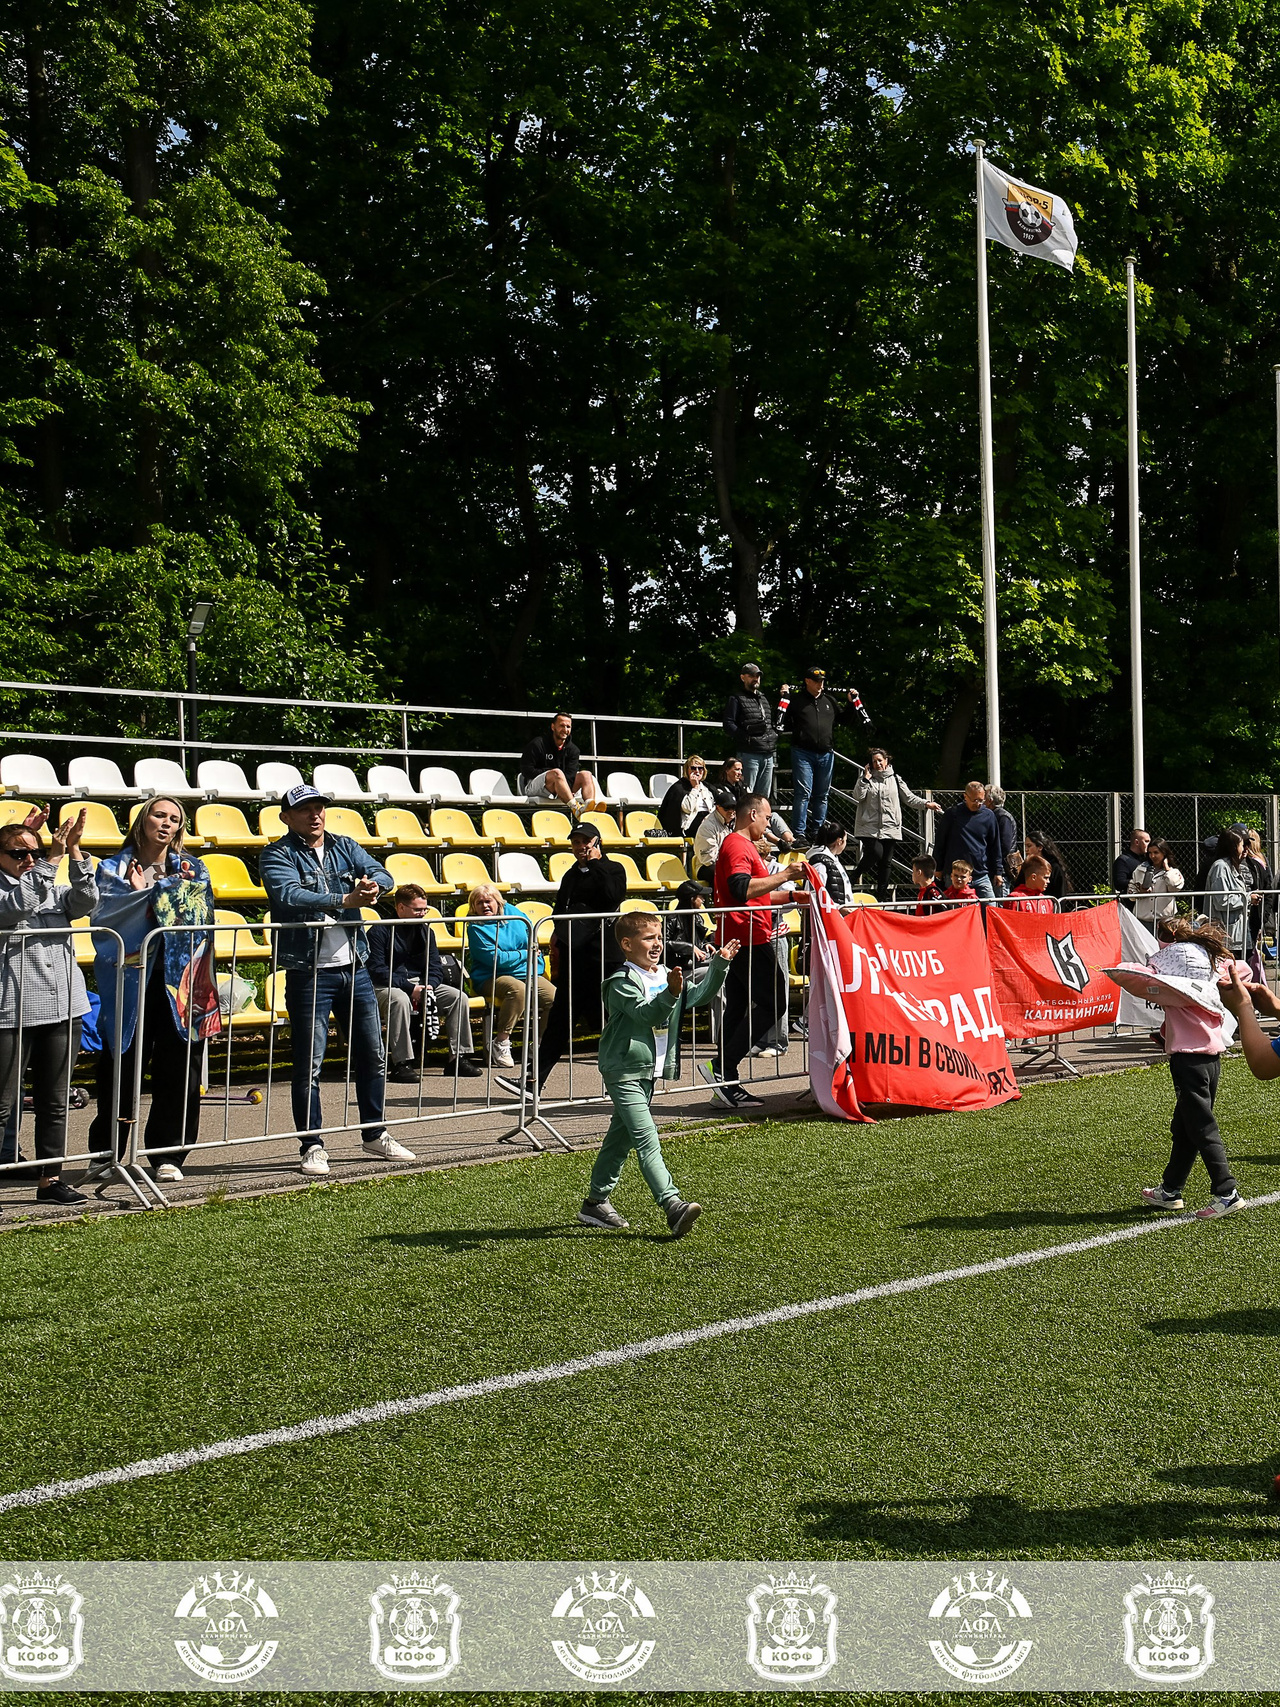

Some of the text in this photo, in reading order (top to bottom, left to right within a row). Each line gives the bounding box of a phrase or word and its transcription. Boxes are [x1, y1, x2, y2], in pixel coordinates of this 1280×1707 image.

[889, 948, 945, 977] КЛУБ
[1024, 1001, 1115, 1020] КАЛИНИНГРАД
[1035, 993, 1112, 1006] ФУТБОЛЬНЫЙ КЛУБ
[864, 1032, 910, 1066] МЫ
[918, 1037, 931, 1068] В
